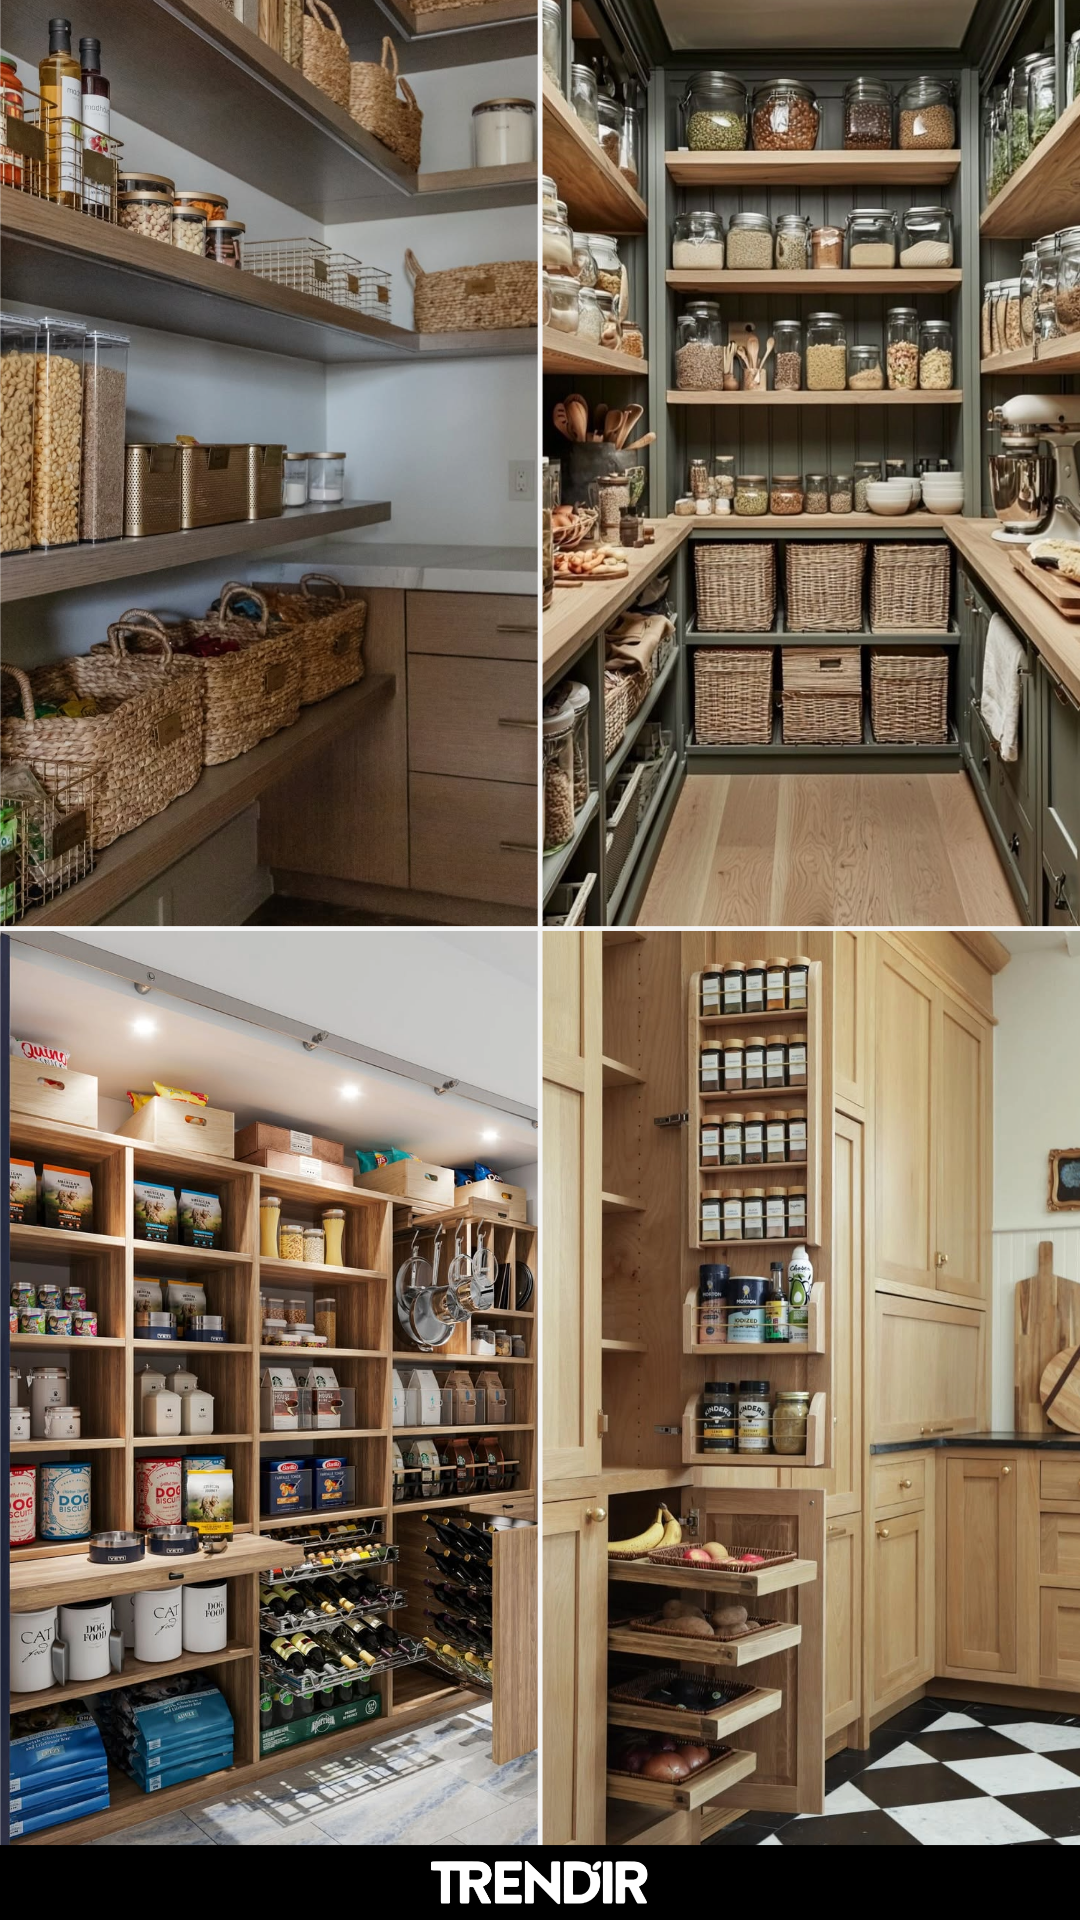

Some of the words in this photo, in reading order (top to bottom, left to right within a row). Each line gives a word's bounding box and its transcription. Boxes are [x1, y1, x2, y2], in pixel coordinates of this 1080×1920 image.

[156, 1486, 180, 1498] DOG
[10, 1497, 33, 1511] OG
[59, 1493, 89, 1506] DOG
[10, 1508, 33, 1519] SCUITS
[59, 1504, 89, 1513] BISCUITS
[154, 1604, 180, 1618] CAT
[208, 1601, 223, 1610] DOG
[205, 1608, 224, 1617] FOOD
[86, 1623, 105, 1633] DOG
[21, 1627, 52, 1644] CAT
[84, 1630, 106, 1642] FOOD
